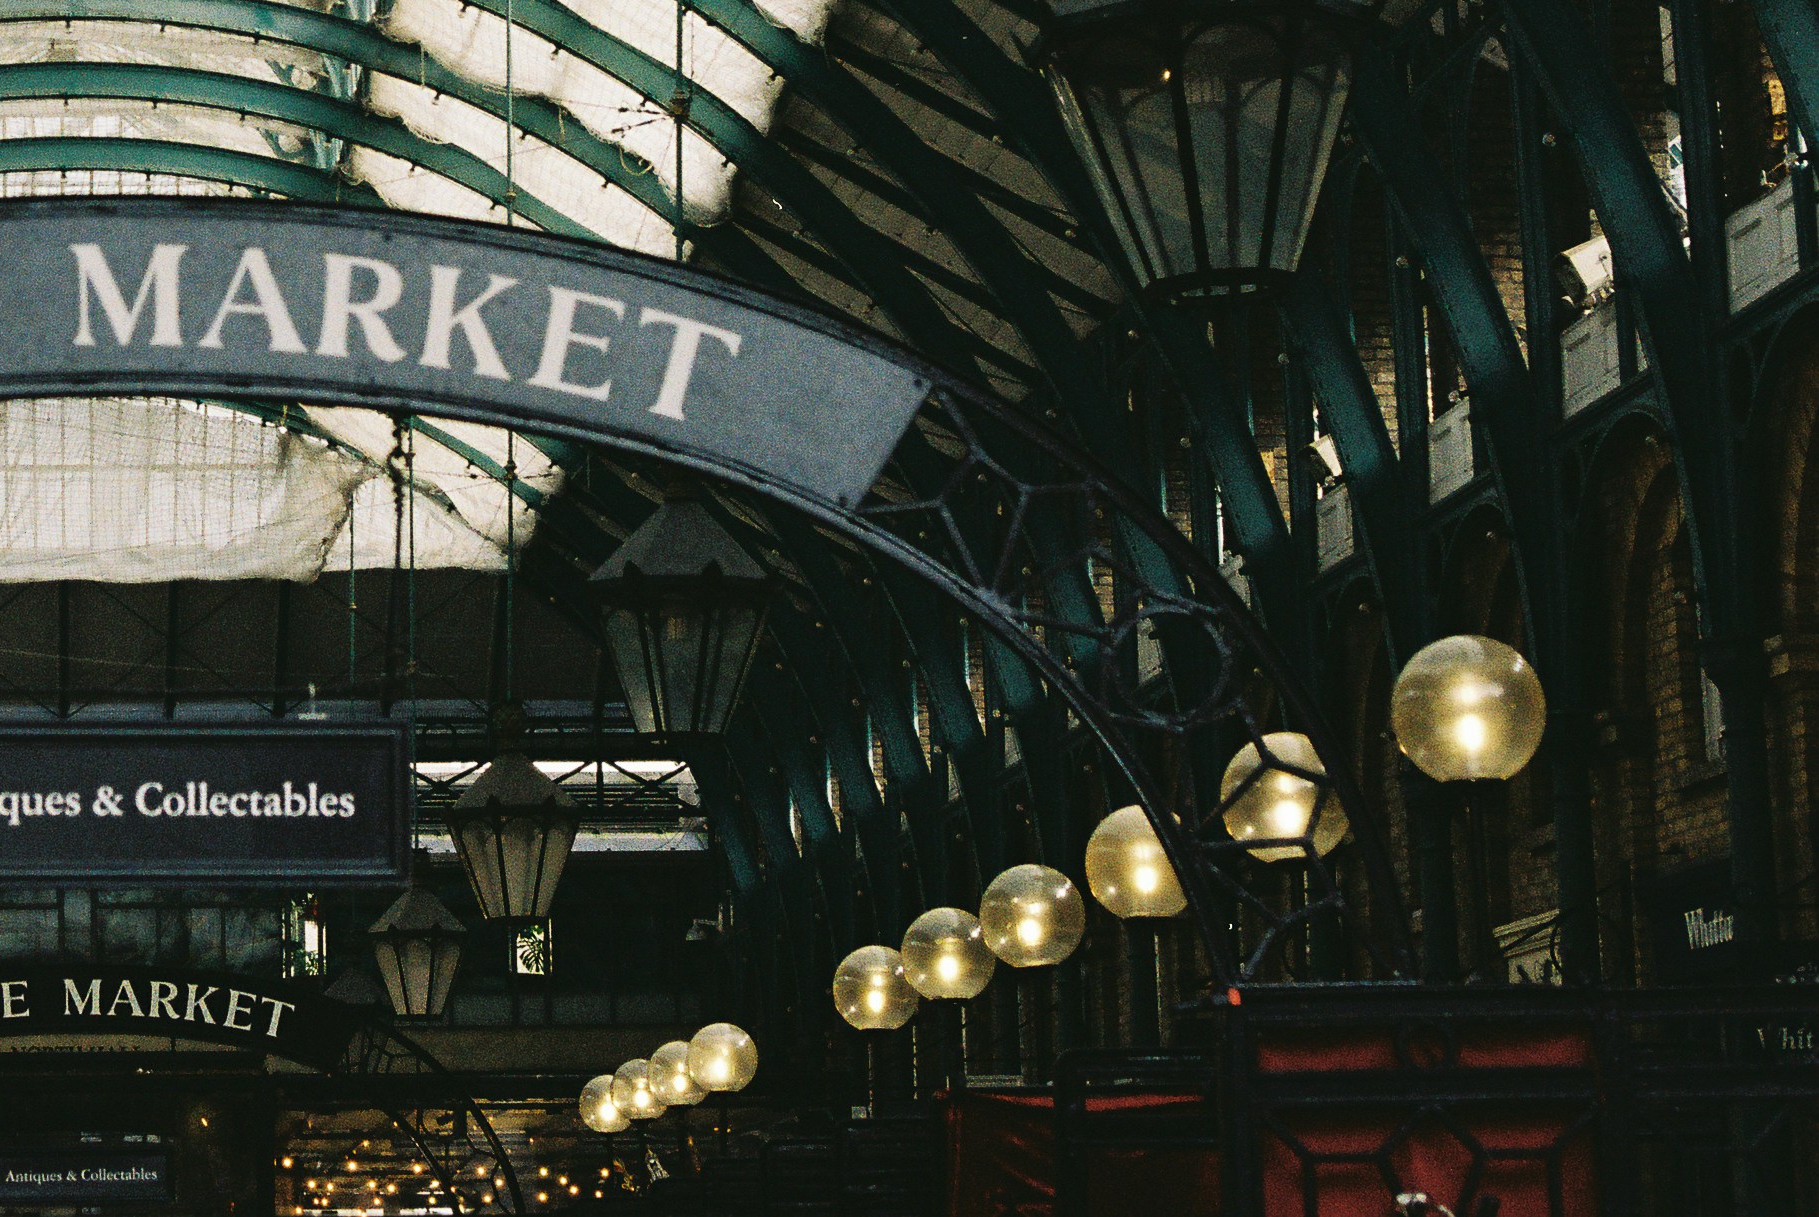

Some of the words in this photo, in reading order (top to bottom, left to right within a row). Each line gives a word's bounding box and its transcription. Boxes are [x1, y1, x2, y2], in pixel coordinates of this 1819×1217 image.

[68, 242, 743, 423] MARKET
[92, 784, 124, 818] &
[134, 781, 356, 818] Collectables
[63, 977, 296, 1038] MARKET
[5, 1169, 63, 1185] Antiques
[66, 1170, 78, 1182] &
[80, 1167, 158, 1182] Collectables
